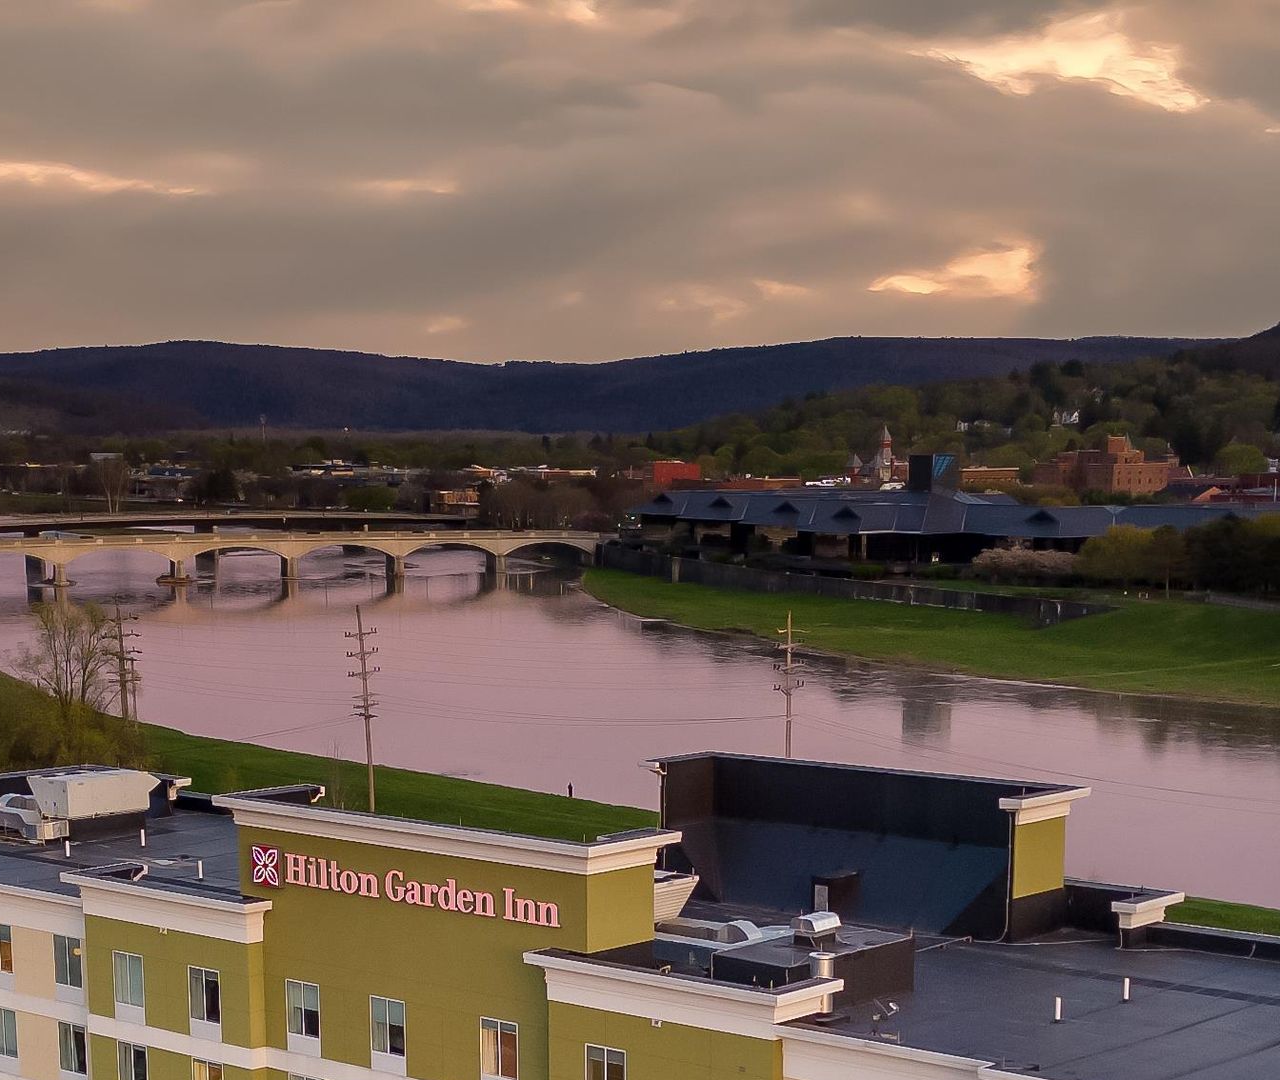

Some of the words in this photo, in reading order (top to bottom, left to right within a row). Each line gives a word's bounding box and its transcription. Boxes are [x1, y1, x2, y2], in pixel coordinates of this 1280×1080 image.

[285, 853, 379, 898] Hilton
[385, 870, 496, 918] Garden
[503, 888, 560, 928] Inn
